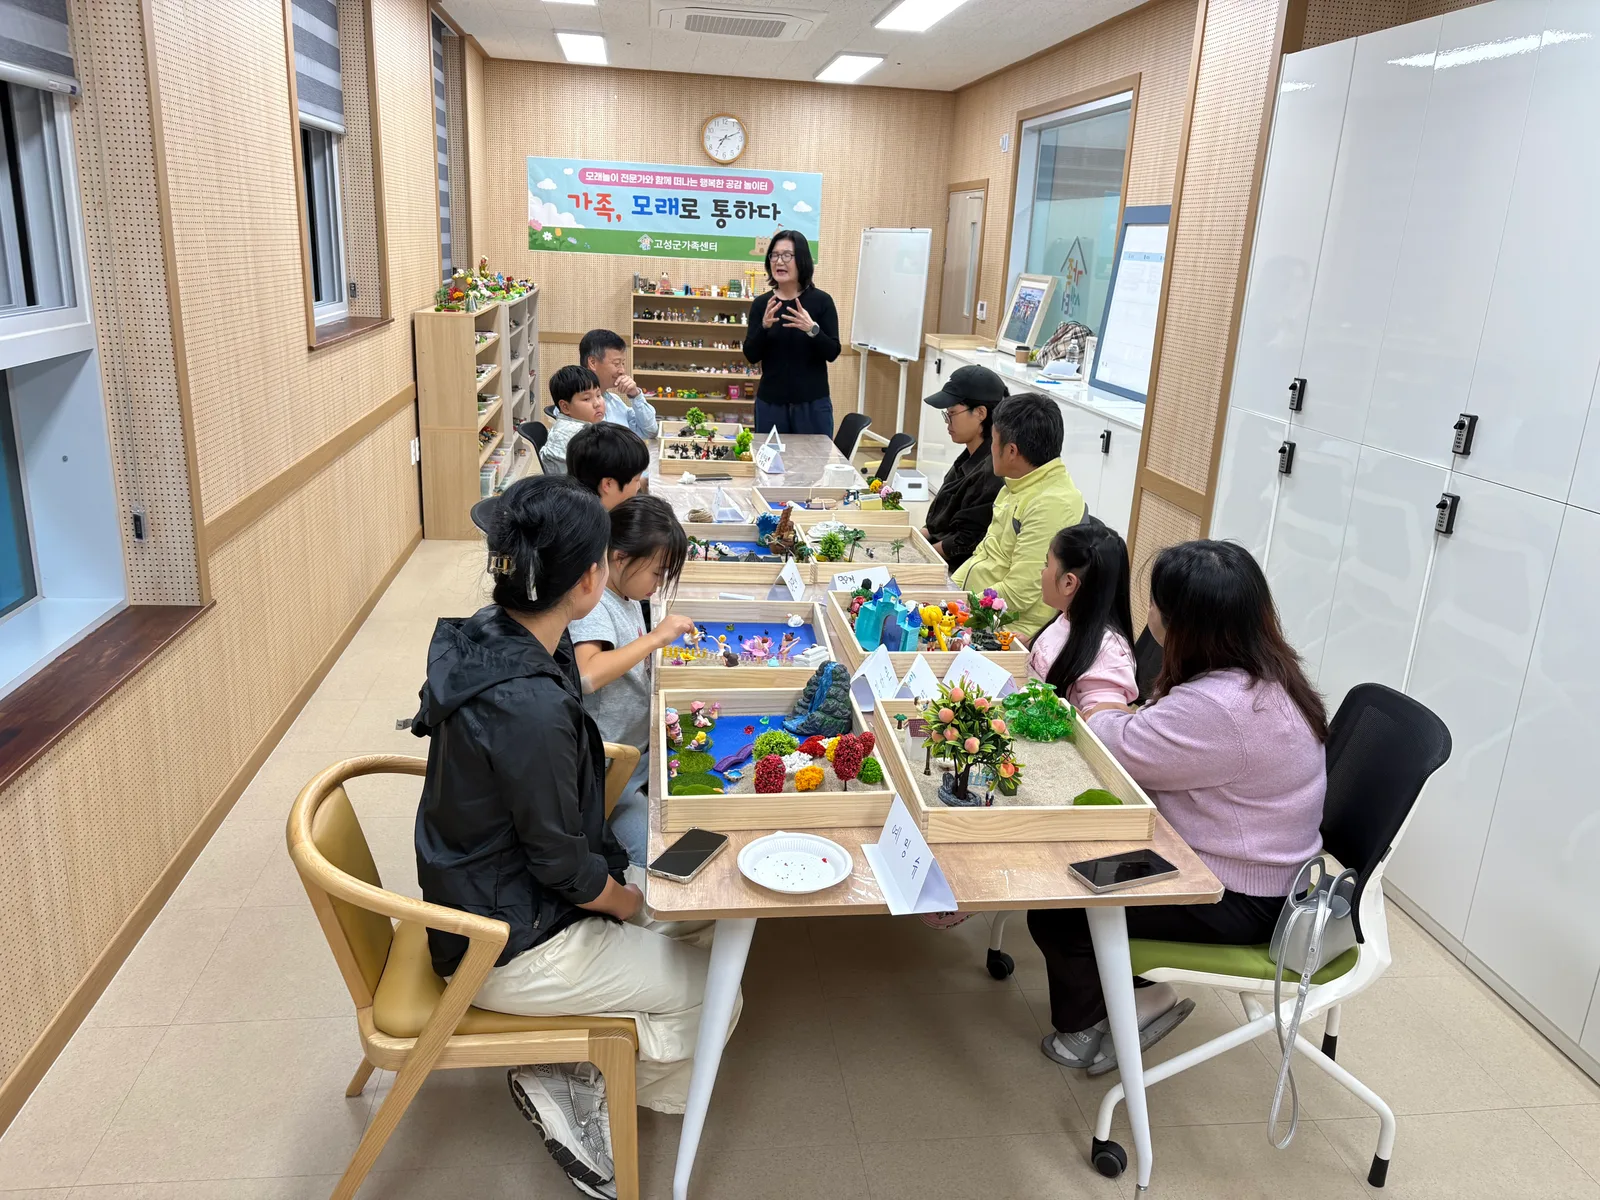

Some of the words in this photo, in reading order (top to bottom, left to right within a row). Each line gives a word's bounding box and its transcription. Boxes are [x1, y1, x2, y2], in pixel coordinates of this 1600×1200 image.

[585, 171, 619, 183] 모래놀이
[620, 173, 654, 185] 전문가와
[655, 175, 672, 186] 함께
[673, 176, 698, 187] 떠나는
[699, 178, 725, 189] 행복한
[725, 179, 742, 190] 공감
[743, 180, 768, 191] 놀이터
[567, 192, 622, 223] 가족,
[631, 195, 701, 220] 모래로
[711, 199, 781, 229] 통하다
[653, 239, 718, 253] 고성군가족센터
